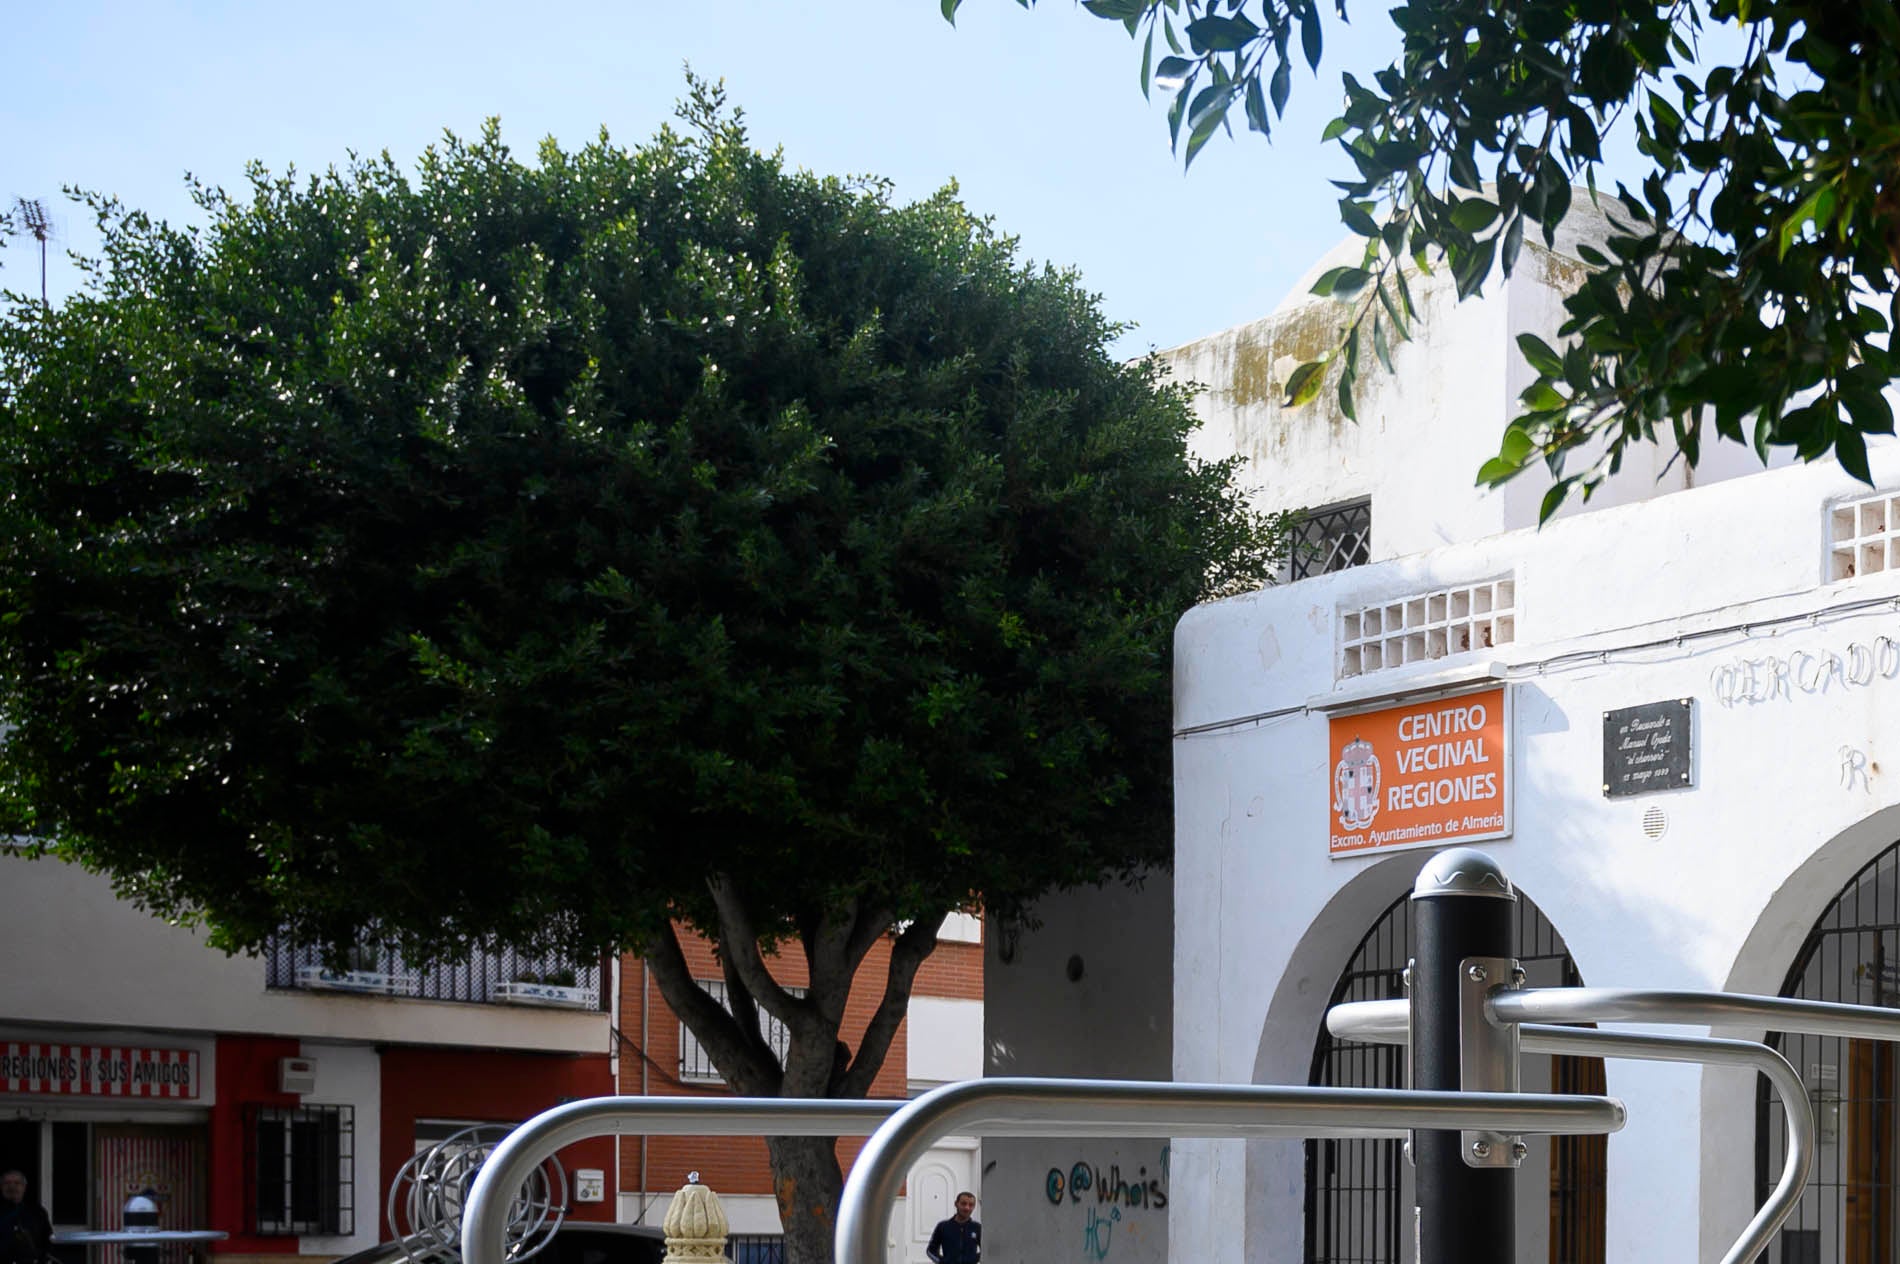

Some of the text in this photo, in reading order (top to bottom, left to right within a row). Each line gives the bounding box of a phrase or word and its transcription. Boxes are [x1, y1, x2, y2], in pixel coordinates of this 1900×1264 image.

[1398, 704, 1487, 742] CENTRO
[1396, 738, 1489, 774] VECINAL
[1387, 772, 1497, 811] REGIONES
[1331, 810, 1503, 848] Excmo. Ayuntamiento de Almería
[1, 1056, 190, 1085] REGIONES Y SUS AMIGOS
